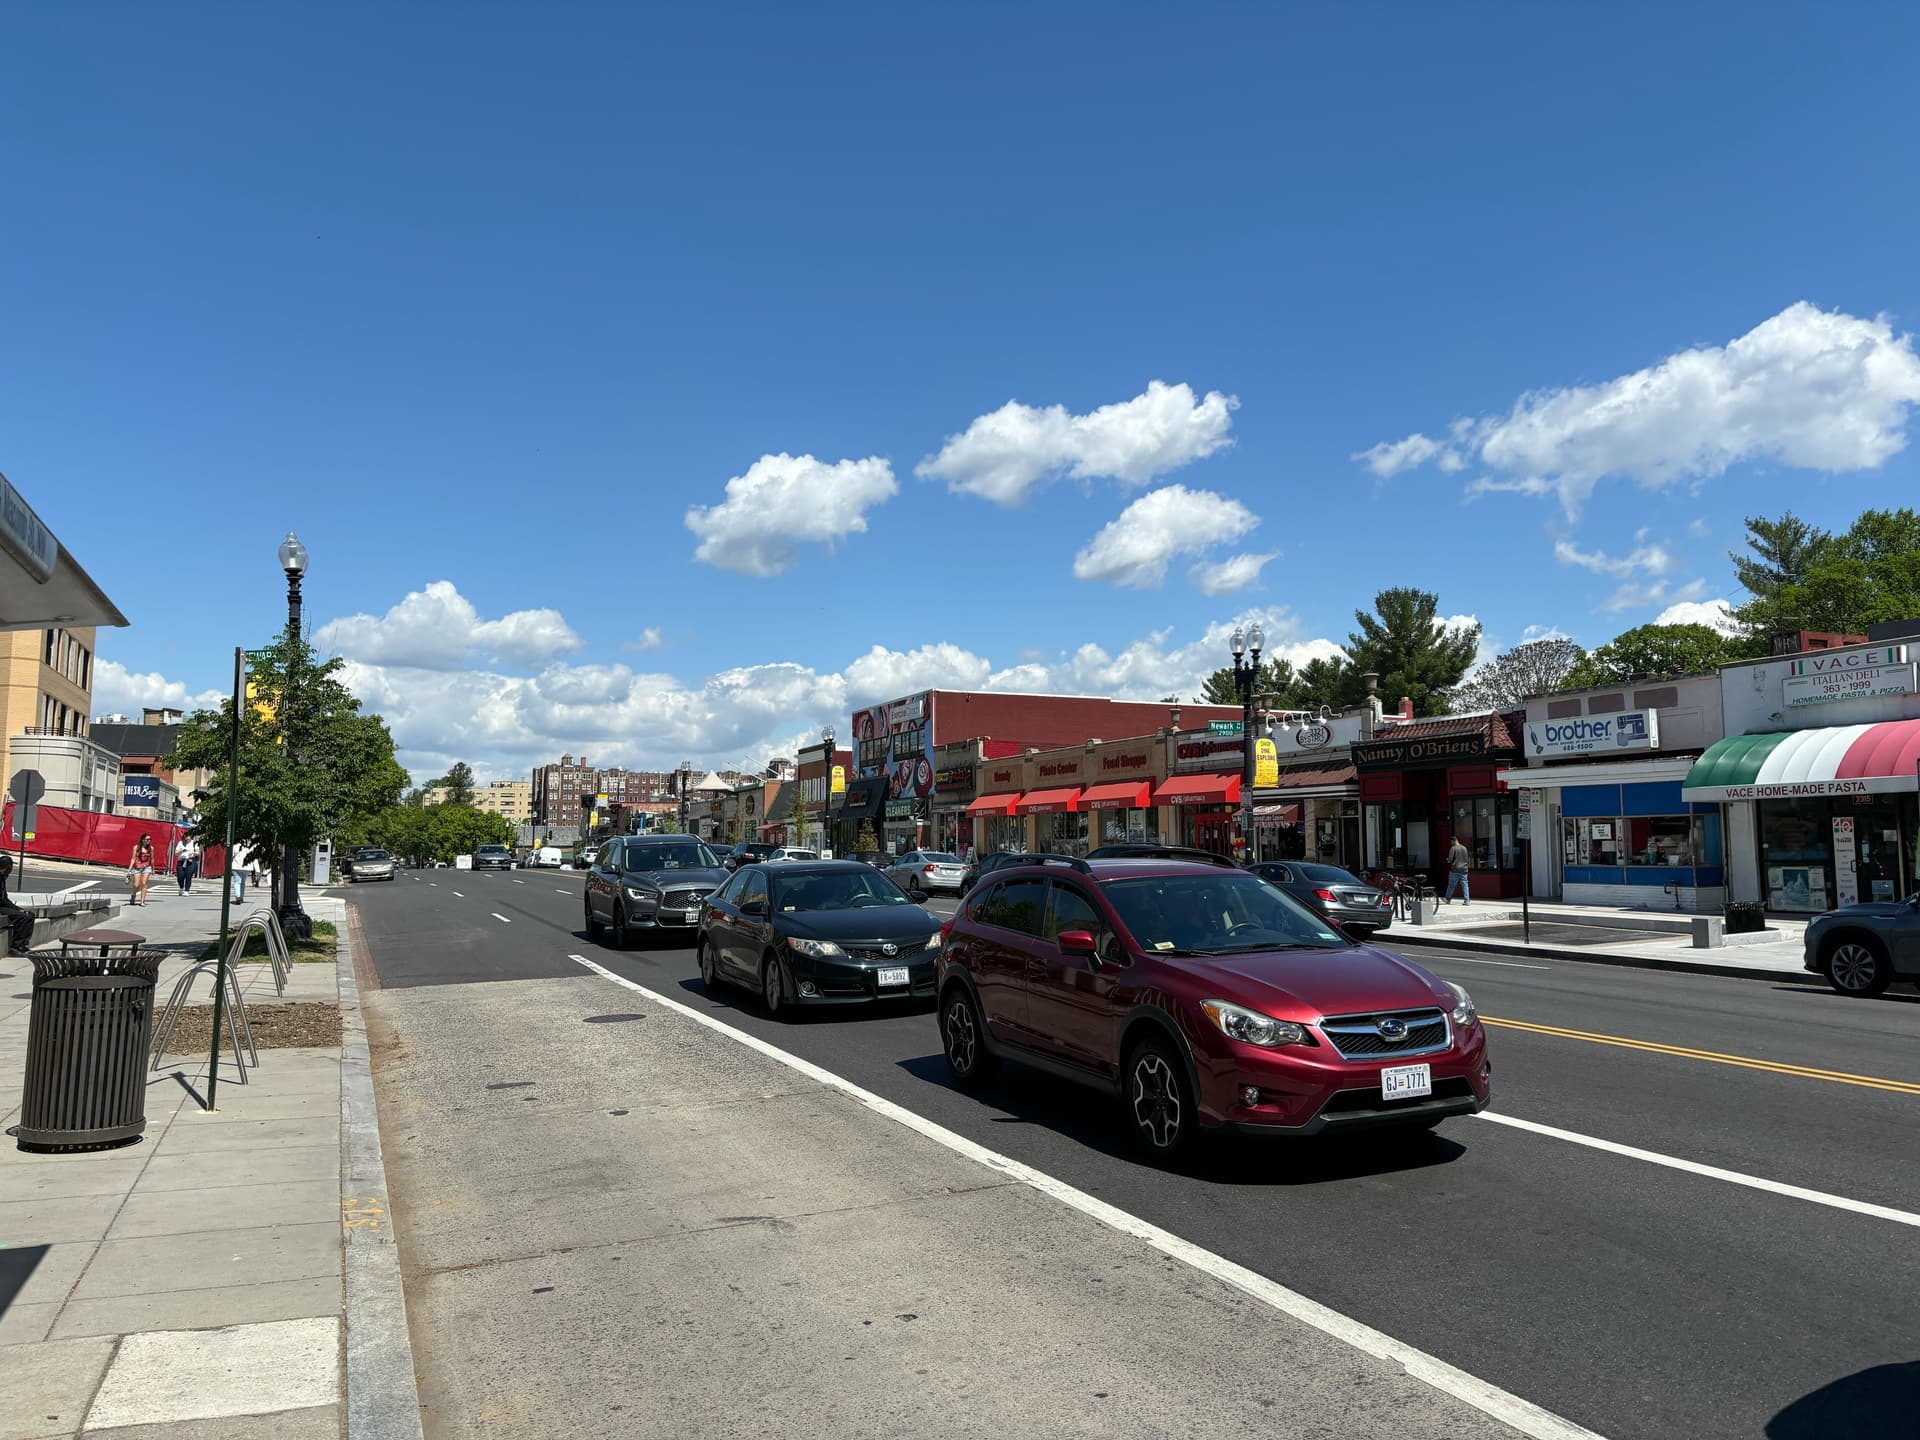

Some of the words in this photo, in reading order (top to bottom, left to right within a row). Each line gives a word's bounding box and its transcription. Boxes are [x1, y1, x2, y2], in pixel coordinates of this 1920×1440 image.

[1813, 653, 1878, 670] VACE
[1813, 673, 1853, 685] ITALIAN
[1856, 669, 1880, 681] DELI
[1793, 694, 1838, 704] HOMEMADE
[1841, 690, 1866, 699] PASTA
[1880, 686, 1905, 695] PIZZA
[1210, 722, 1233, 730] Newark
[1545, 720, 1611, 741] brother
[1358, 746, 1403, 762] Nanny
[1727, 788, 1753, 798] VACE
[1757, 785, 1824, 797] HOME-MADE
[1828, 782, 1866, 792] PASTA
[885, 805, 911, 817] CLEANERS
[1386, 1076, 1397, 1091] GJ
[1406, 1072, 1426, 1089] 1771
